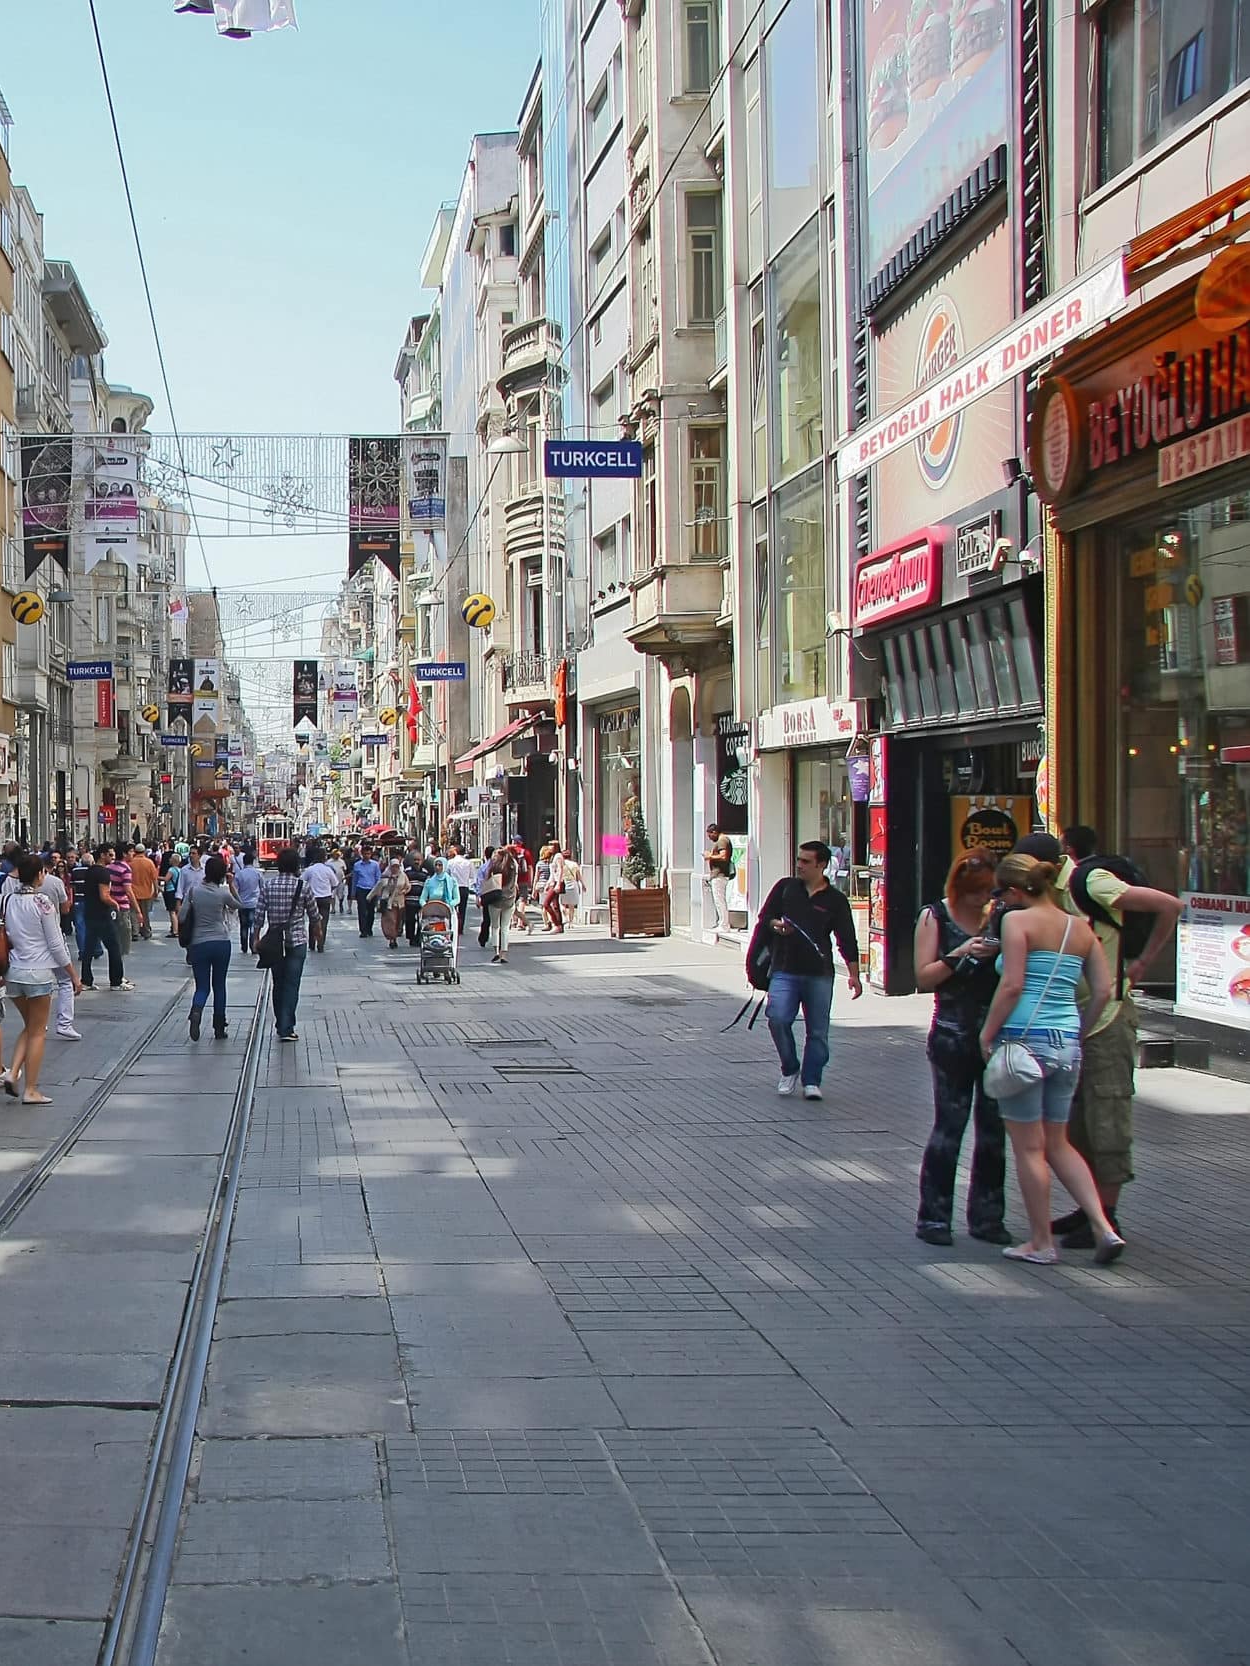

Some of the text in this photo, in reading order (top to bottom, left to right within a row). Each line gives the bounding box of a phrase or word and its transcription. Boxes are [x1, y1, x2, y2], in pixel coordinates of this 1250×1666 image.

[858, 298, 1083, 462] BEYOĞLU HALK DÖNER
[1088, 349, 1205, 470] BEYOĞLU
[550, 451, 637, 467] TURKCELL
[68, 666, 109, 676] TURKCELL
[419, 667, 463, 677] TURKCELL
[1190, 896, 1232, 912] OSMANLI
